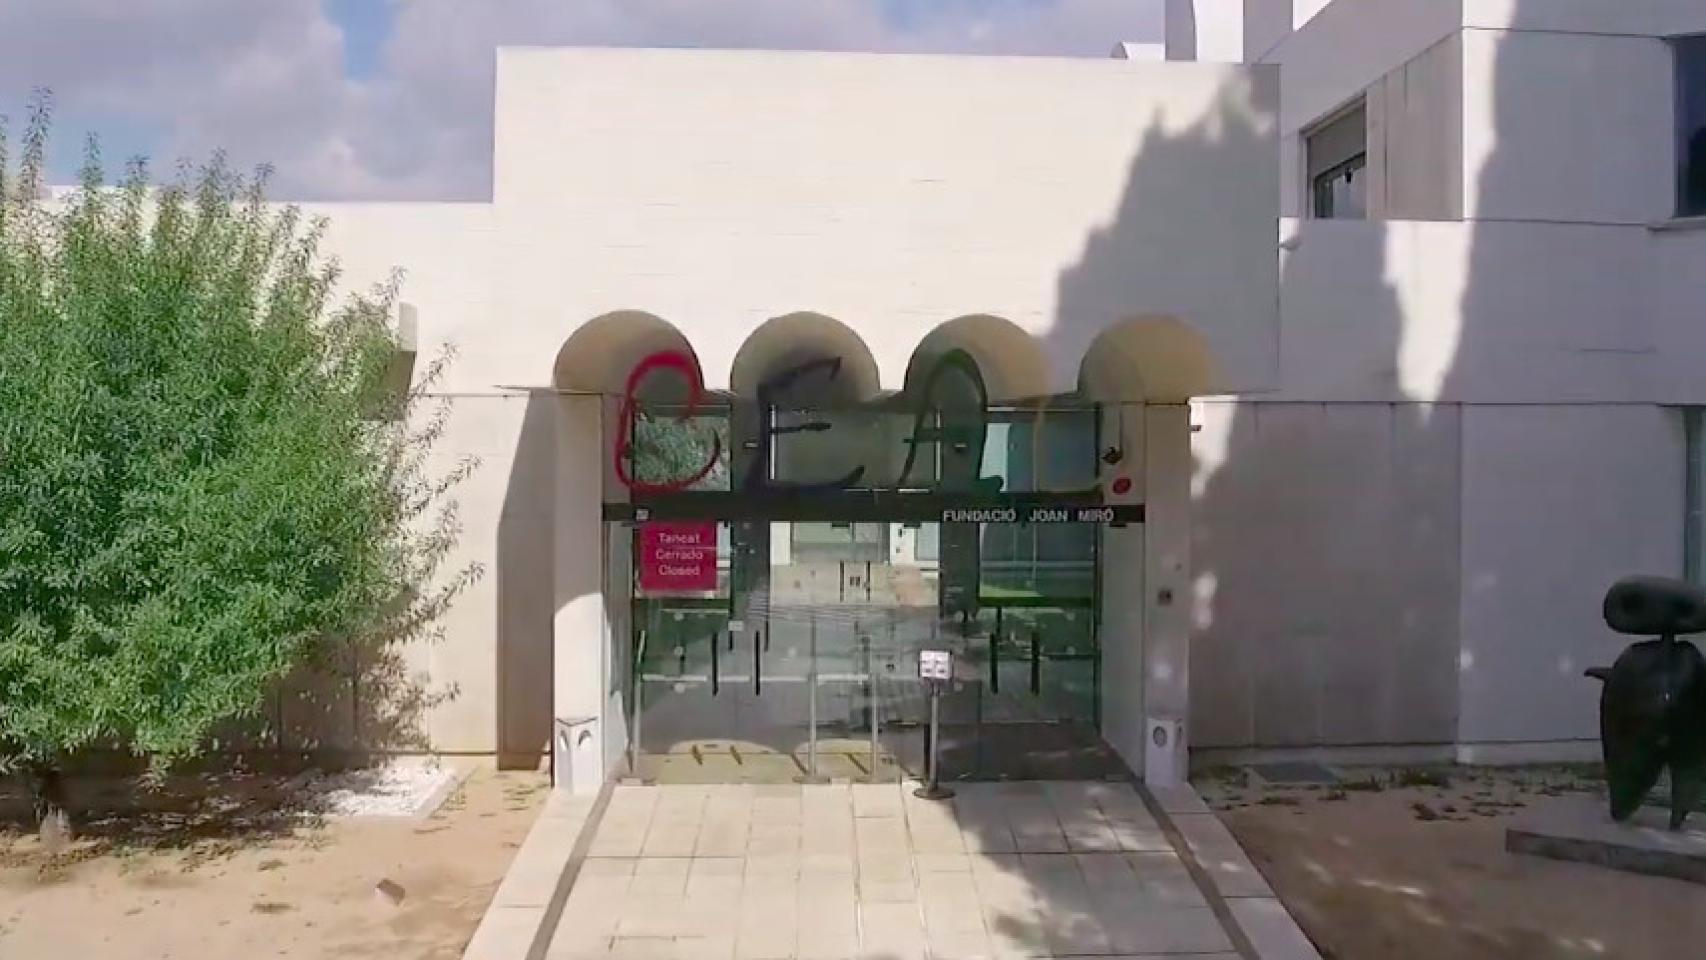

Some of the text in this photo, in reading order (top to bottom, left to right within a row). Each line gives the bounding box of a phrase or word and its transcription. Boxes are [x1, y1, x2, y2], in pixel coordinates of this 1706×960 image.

[942, 507, 1115, 522] FUNDACIÓ JOAN MIRÓ
[657, 532, 701, 544] Tancat
[655, 548, 704, 560] Cerrado
[657, 564, 701, 576] Closed
